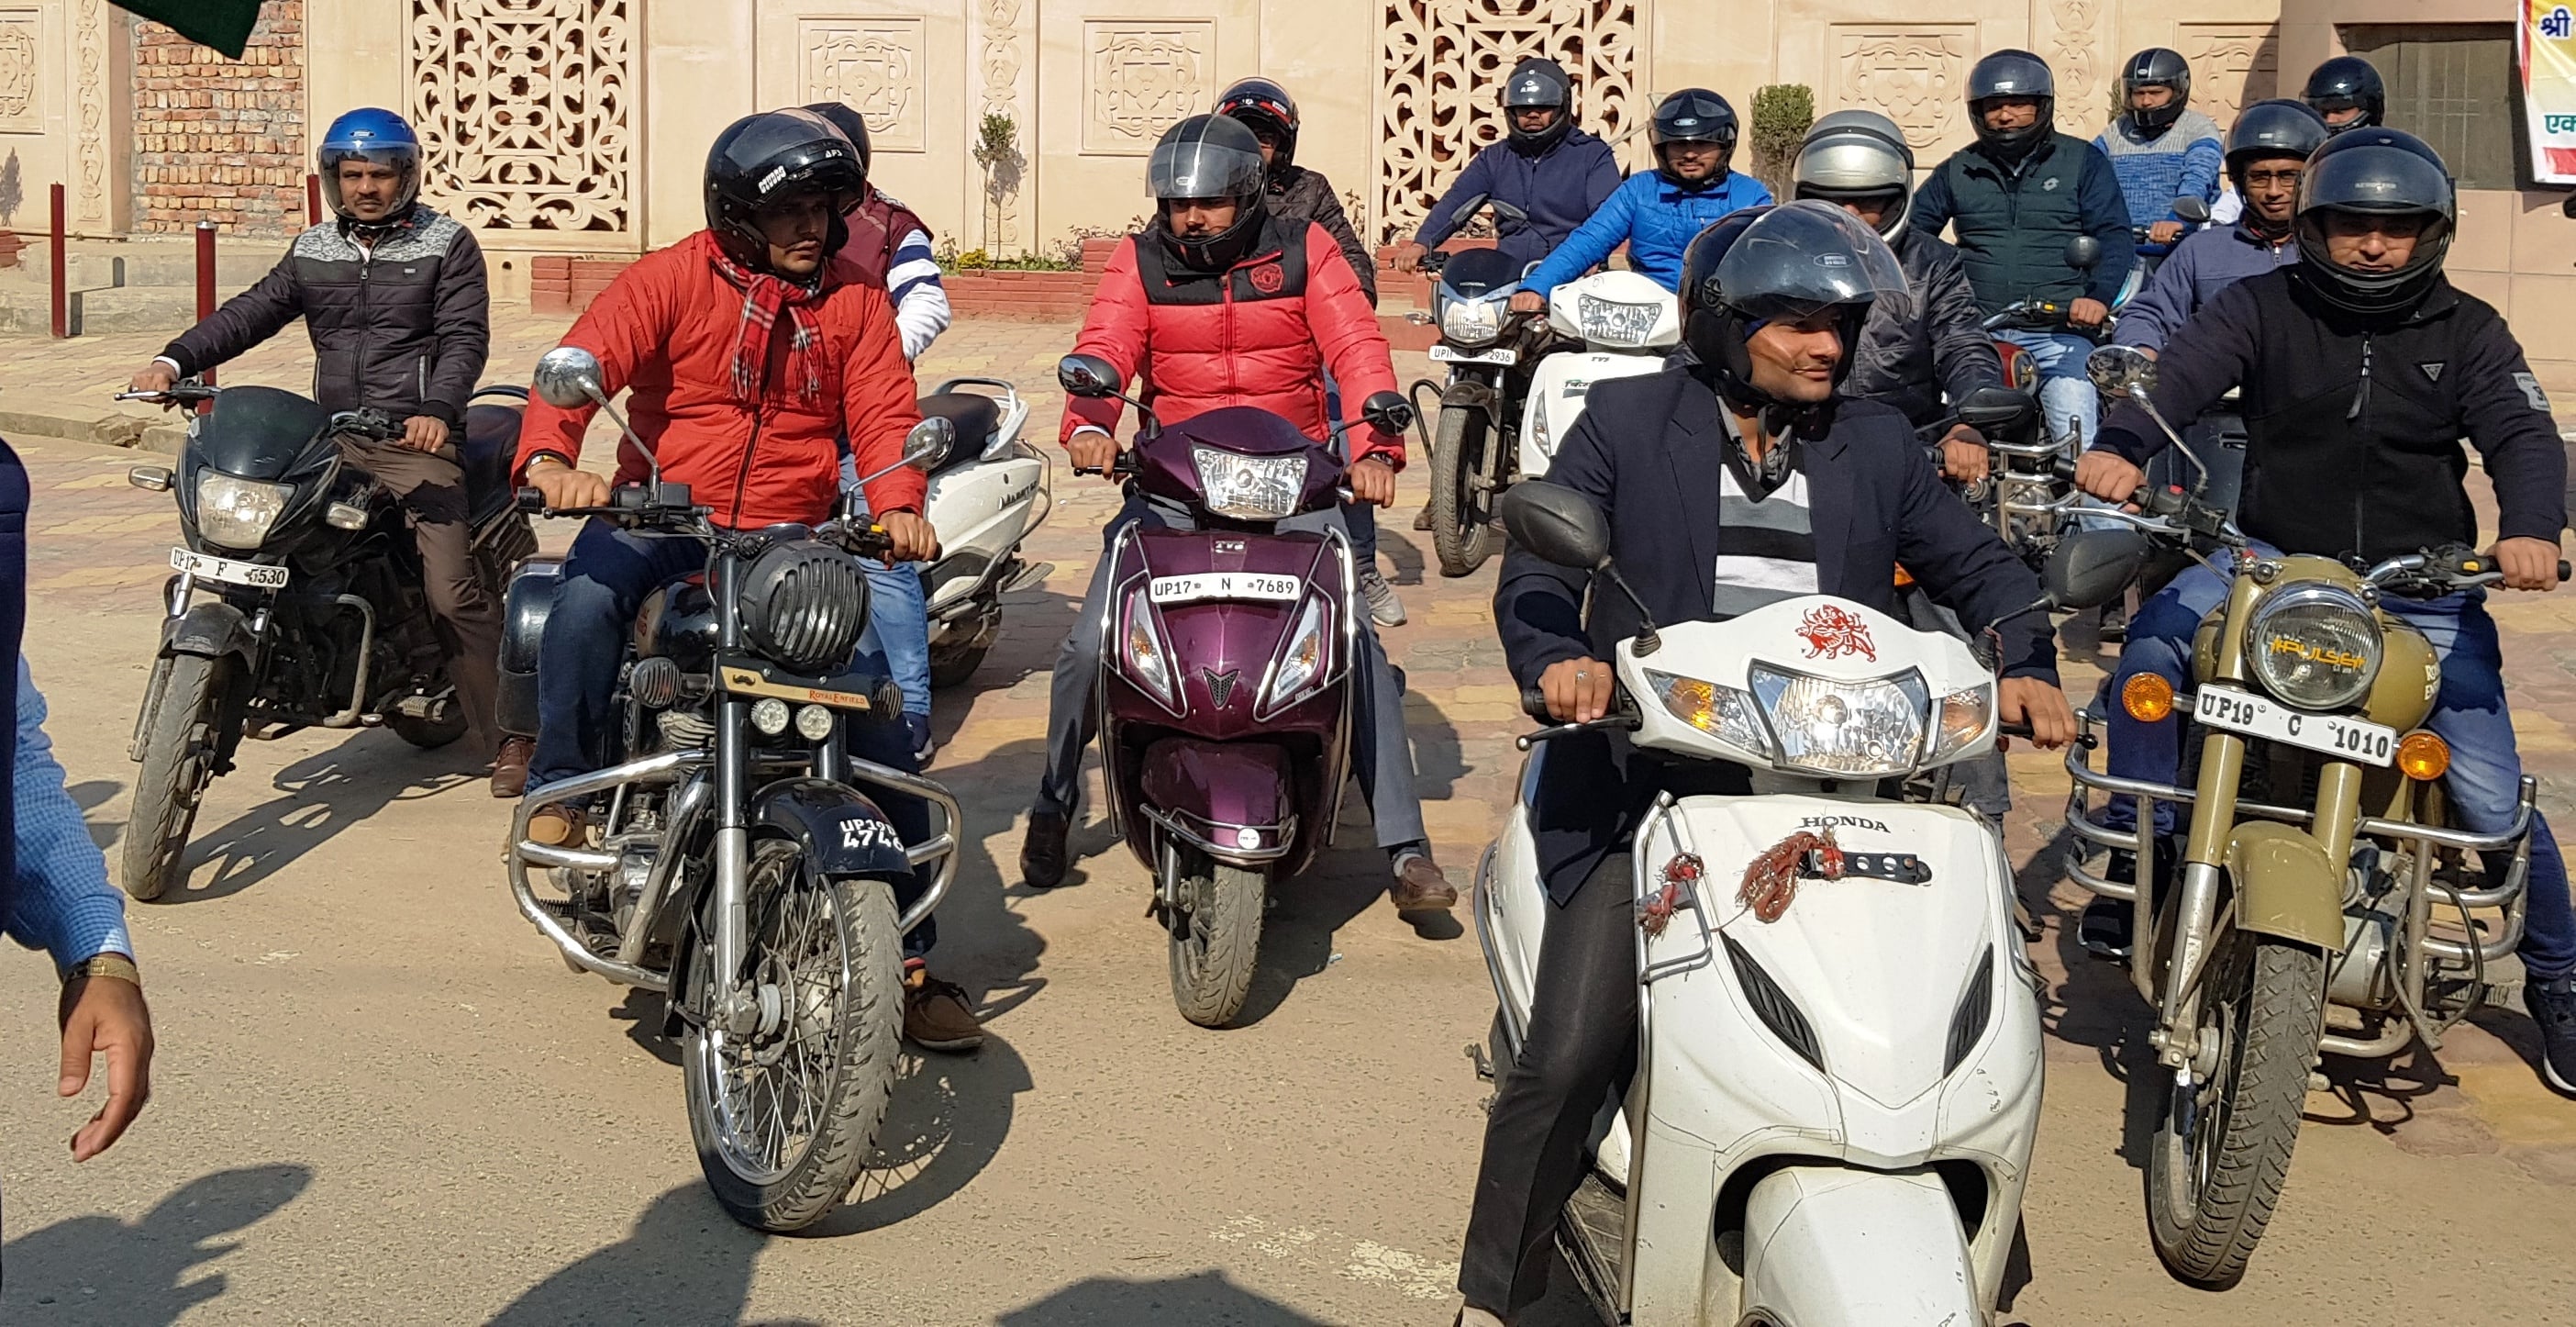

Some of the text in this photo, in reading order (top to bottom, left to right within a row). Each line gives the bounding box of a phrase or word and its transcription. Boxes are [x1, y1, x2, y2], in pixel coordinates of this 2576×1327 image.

[1489, 351, 1512, 362] 2936
[215, 561, 228, 577] F
[1154, 577, 1294, 597] UP17 N 7689
[2201, 693, 2389, 758] UP19 C 1010
[1801, 816, 1892, 833] HONDA
